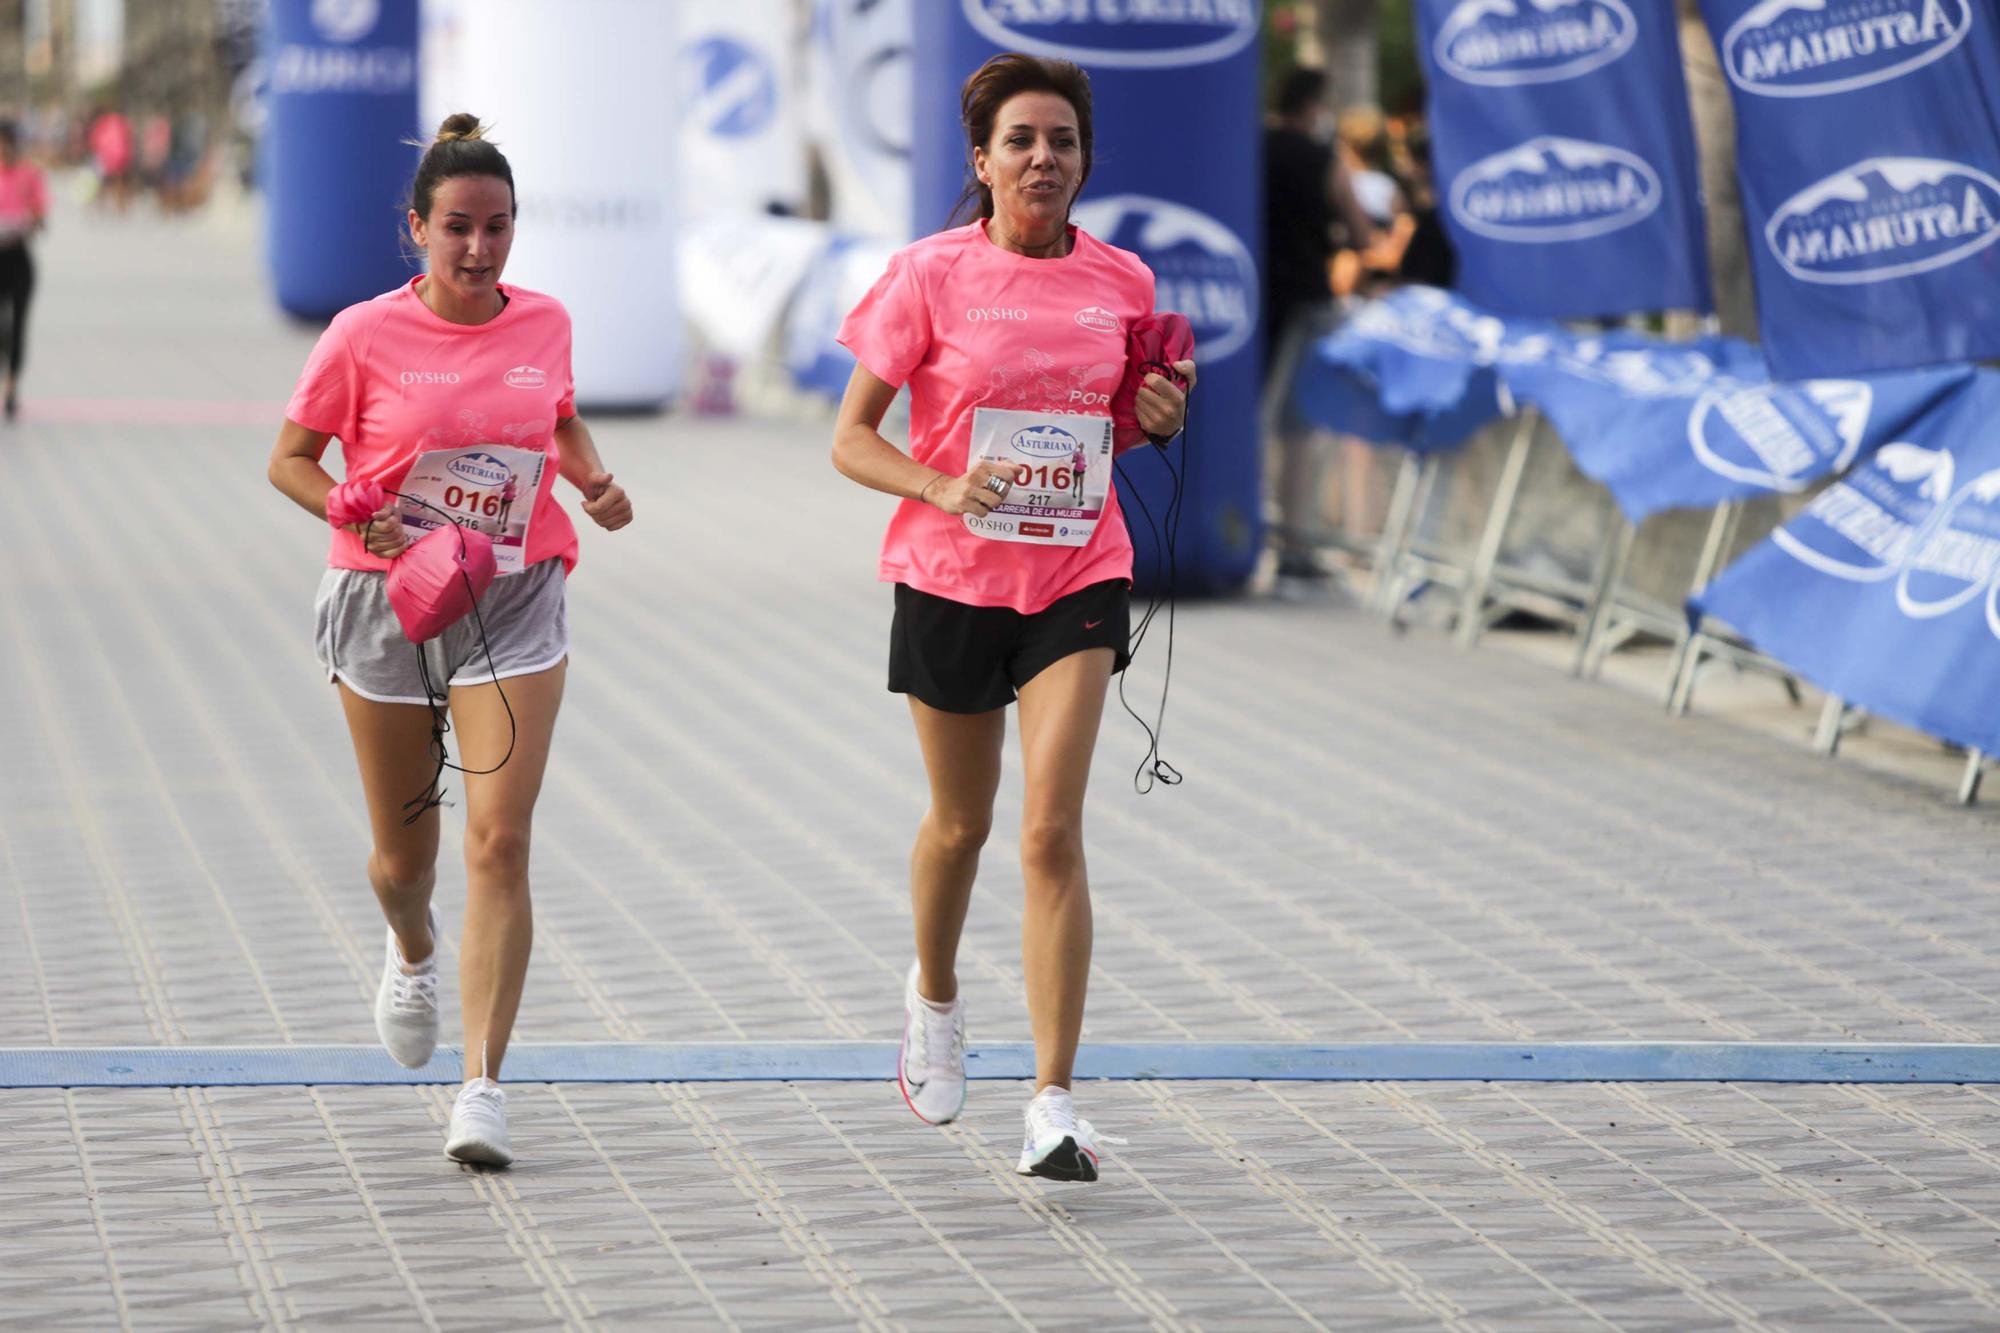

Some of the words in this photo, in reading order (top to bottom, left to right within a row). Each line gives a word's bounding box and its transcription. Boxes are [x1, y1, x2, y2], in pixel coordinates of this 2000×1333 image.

[966, 307, 1028, 321] OYSHO
[401, 371, 461, 384] OYSHO
[1069, 390, 1110, 406] POR
[1016, 435, 1073, 451] ASTURIANA
[450, 459, 506, 481] ASTURIANA
[1014, 463, 1071, 490] 016
[444, 485, 499, 517] 016
[1028, 494, 1051, 506] 217
[1032, 508, 1042, 516] DE
[1044, 509, 1055, 517] LA
[1056, 510, 1082, 518] MUJER
[457, 516, 479, 530] 216
[968, 518, 1014, 533] OYSHO
